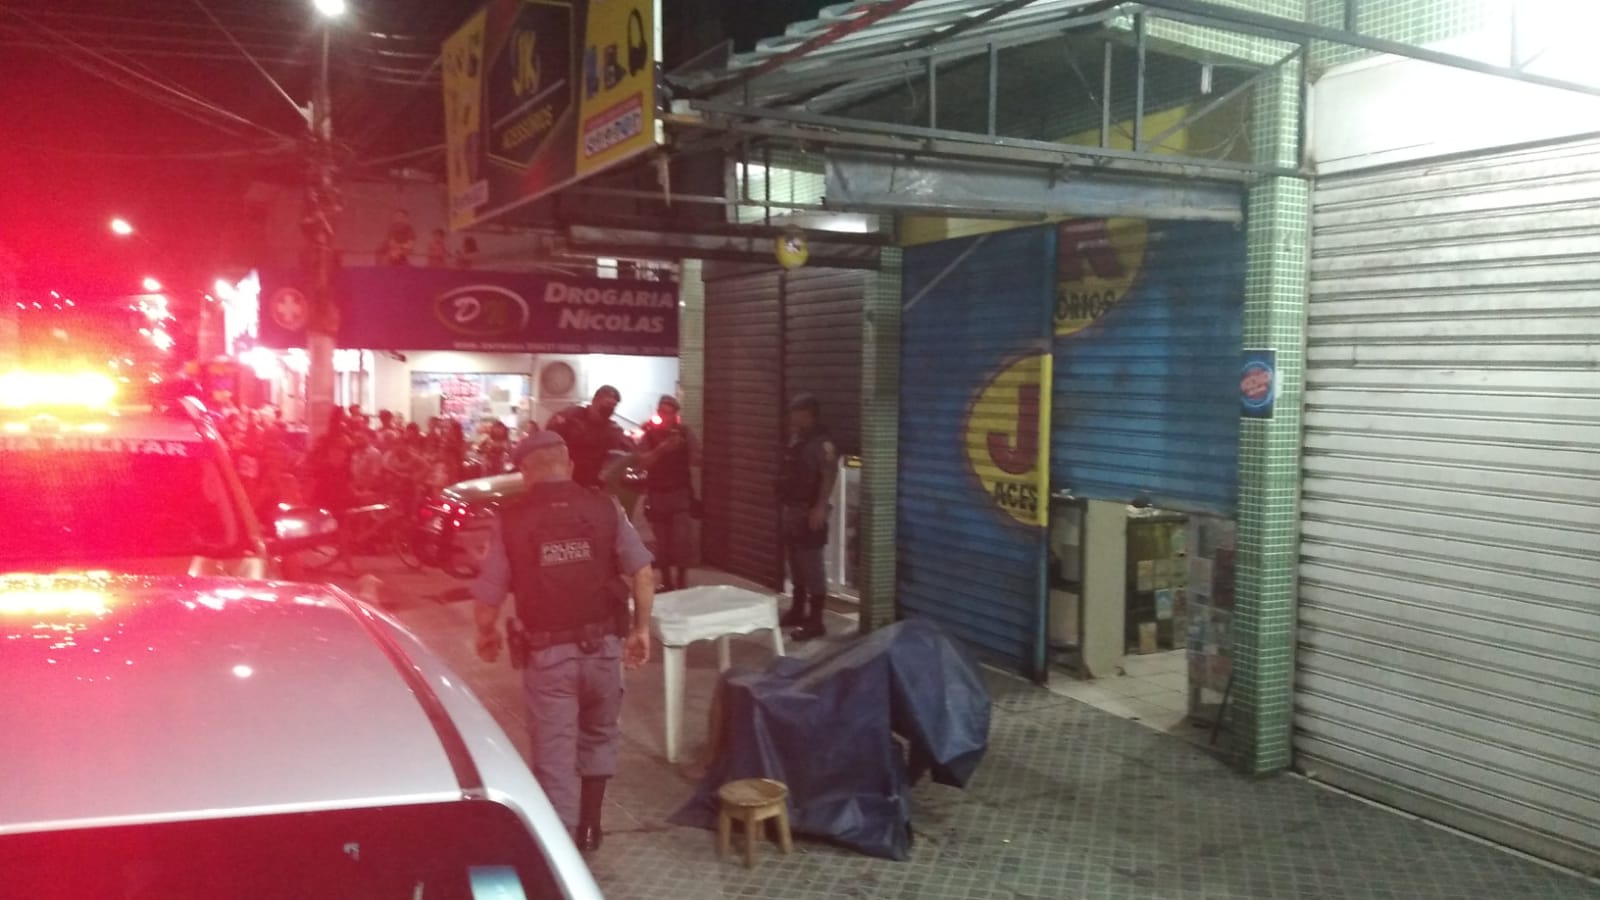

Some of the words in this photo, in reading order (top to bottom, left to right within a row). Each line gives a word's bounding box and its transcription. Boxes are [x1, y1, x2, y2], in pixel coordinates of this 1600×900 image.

[544, 282, 675, 308] DROGARIA
[987, 384, 1041, 475] J
[54, 437, 190, 457] MILITAR
